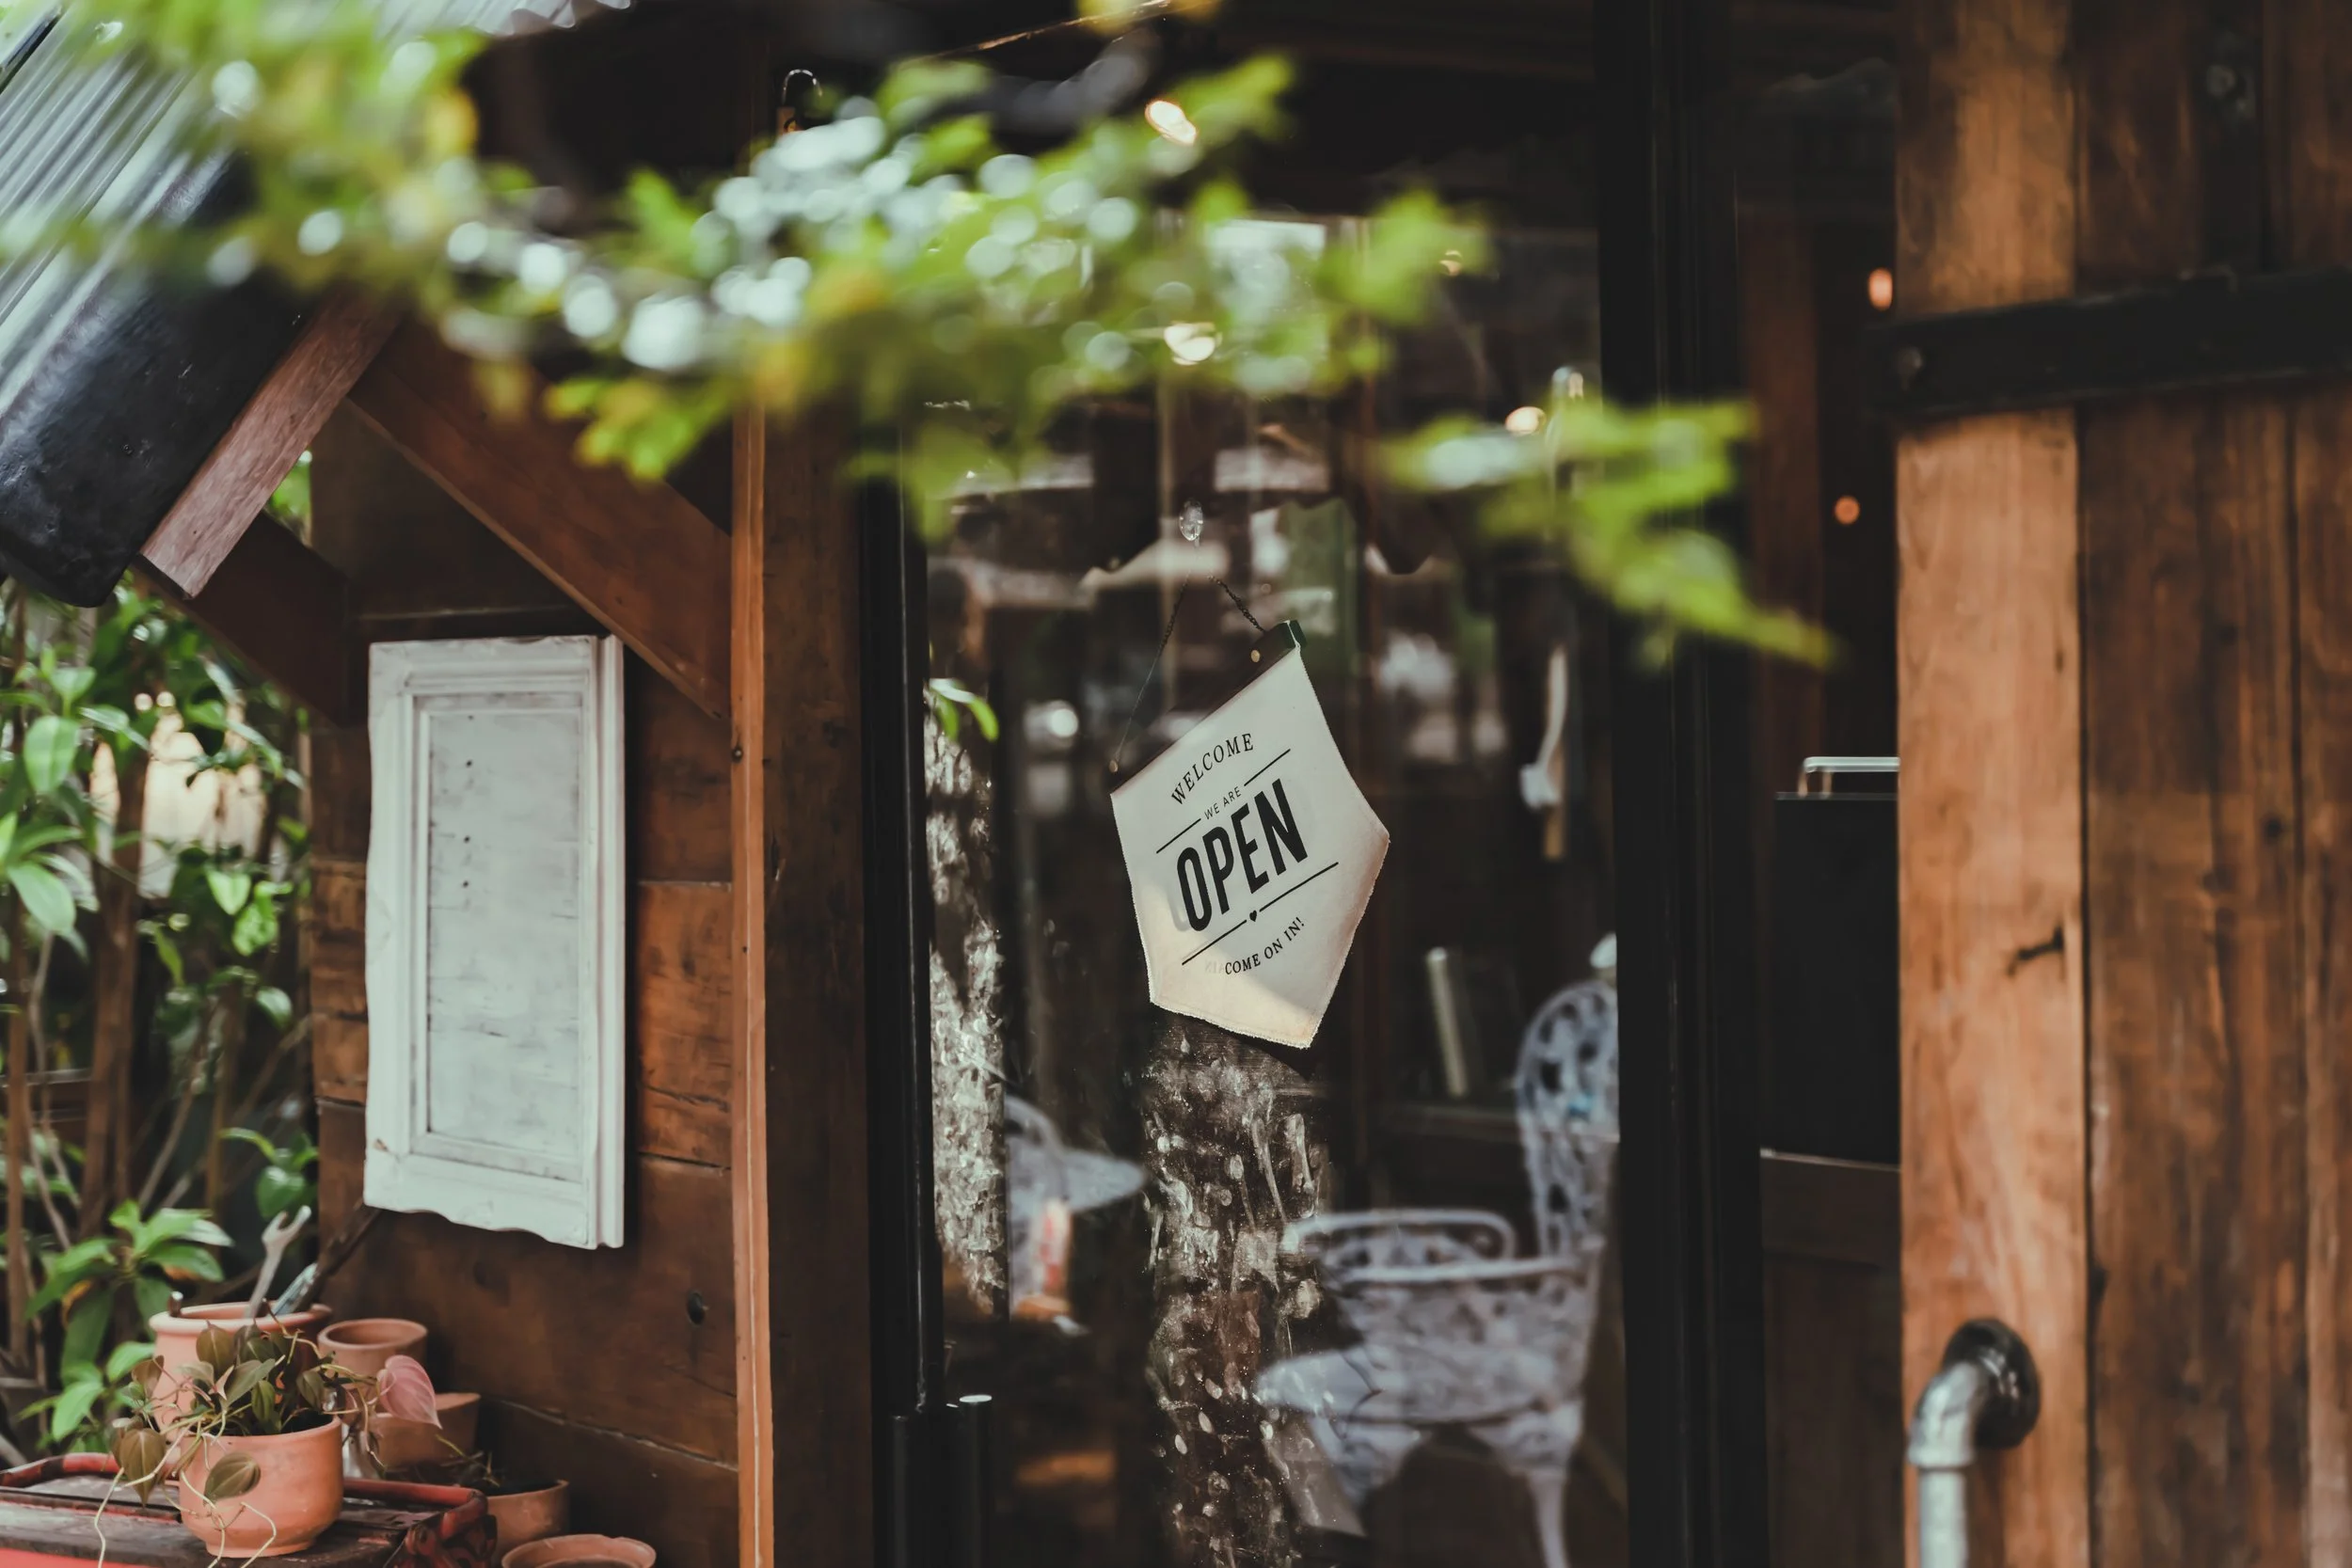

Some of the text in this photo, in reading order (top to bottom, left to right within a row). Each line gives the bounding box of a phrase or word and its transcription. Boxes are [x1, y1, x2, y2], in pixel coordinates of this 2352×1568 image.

[1170, 733, 1254, 805] WELCOME
[1203, 785, 1242, 820] WE ARE
[1176, 778, 1309, 932] OPEN
[1225, 953, 1262, 975] COME
[1263, 938, 1283, 959] ON
[1283, 916, 1306, 942] IN!
